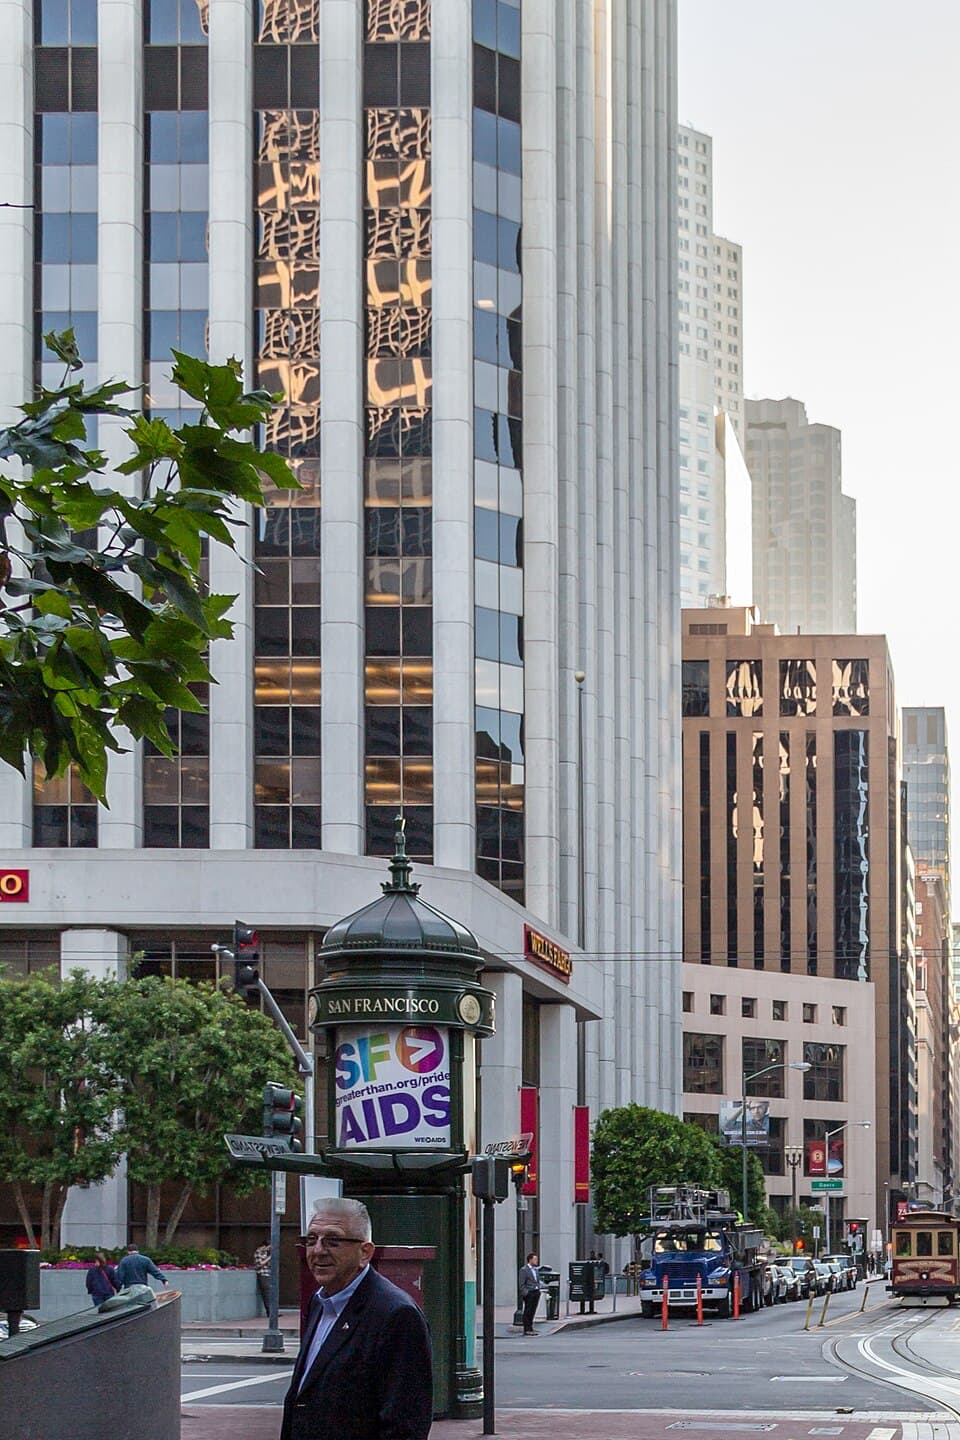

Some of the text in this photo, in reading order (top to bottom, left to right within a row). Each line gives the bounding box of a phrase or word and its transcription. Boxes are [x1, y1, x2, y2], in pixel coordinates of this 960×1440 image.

[531, 931, 573, 976] WELLS FARGO
[328, 998, 439, 1014] SAN FRANCISCO
[336, 1032, 391, 1090] SF
[335, 1071, 450, 1107] greaterthan.org/pride
[338, 1085, 450, 1147] AIDS
